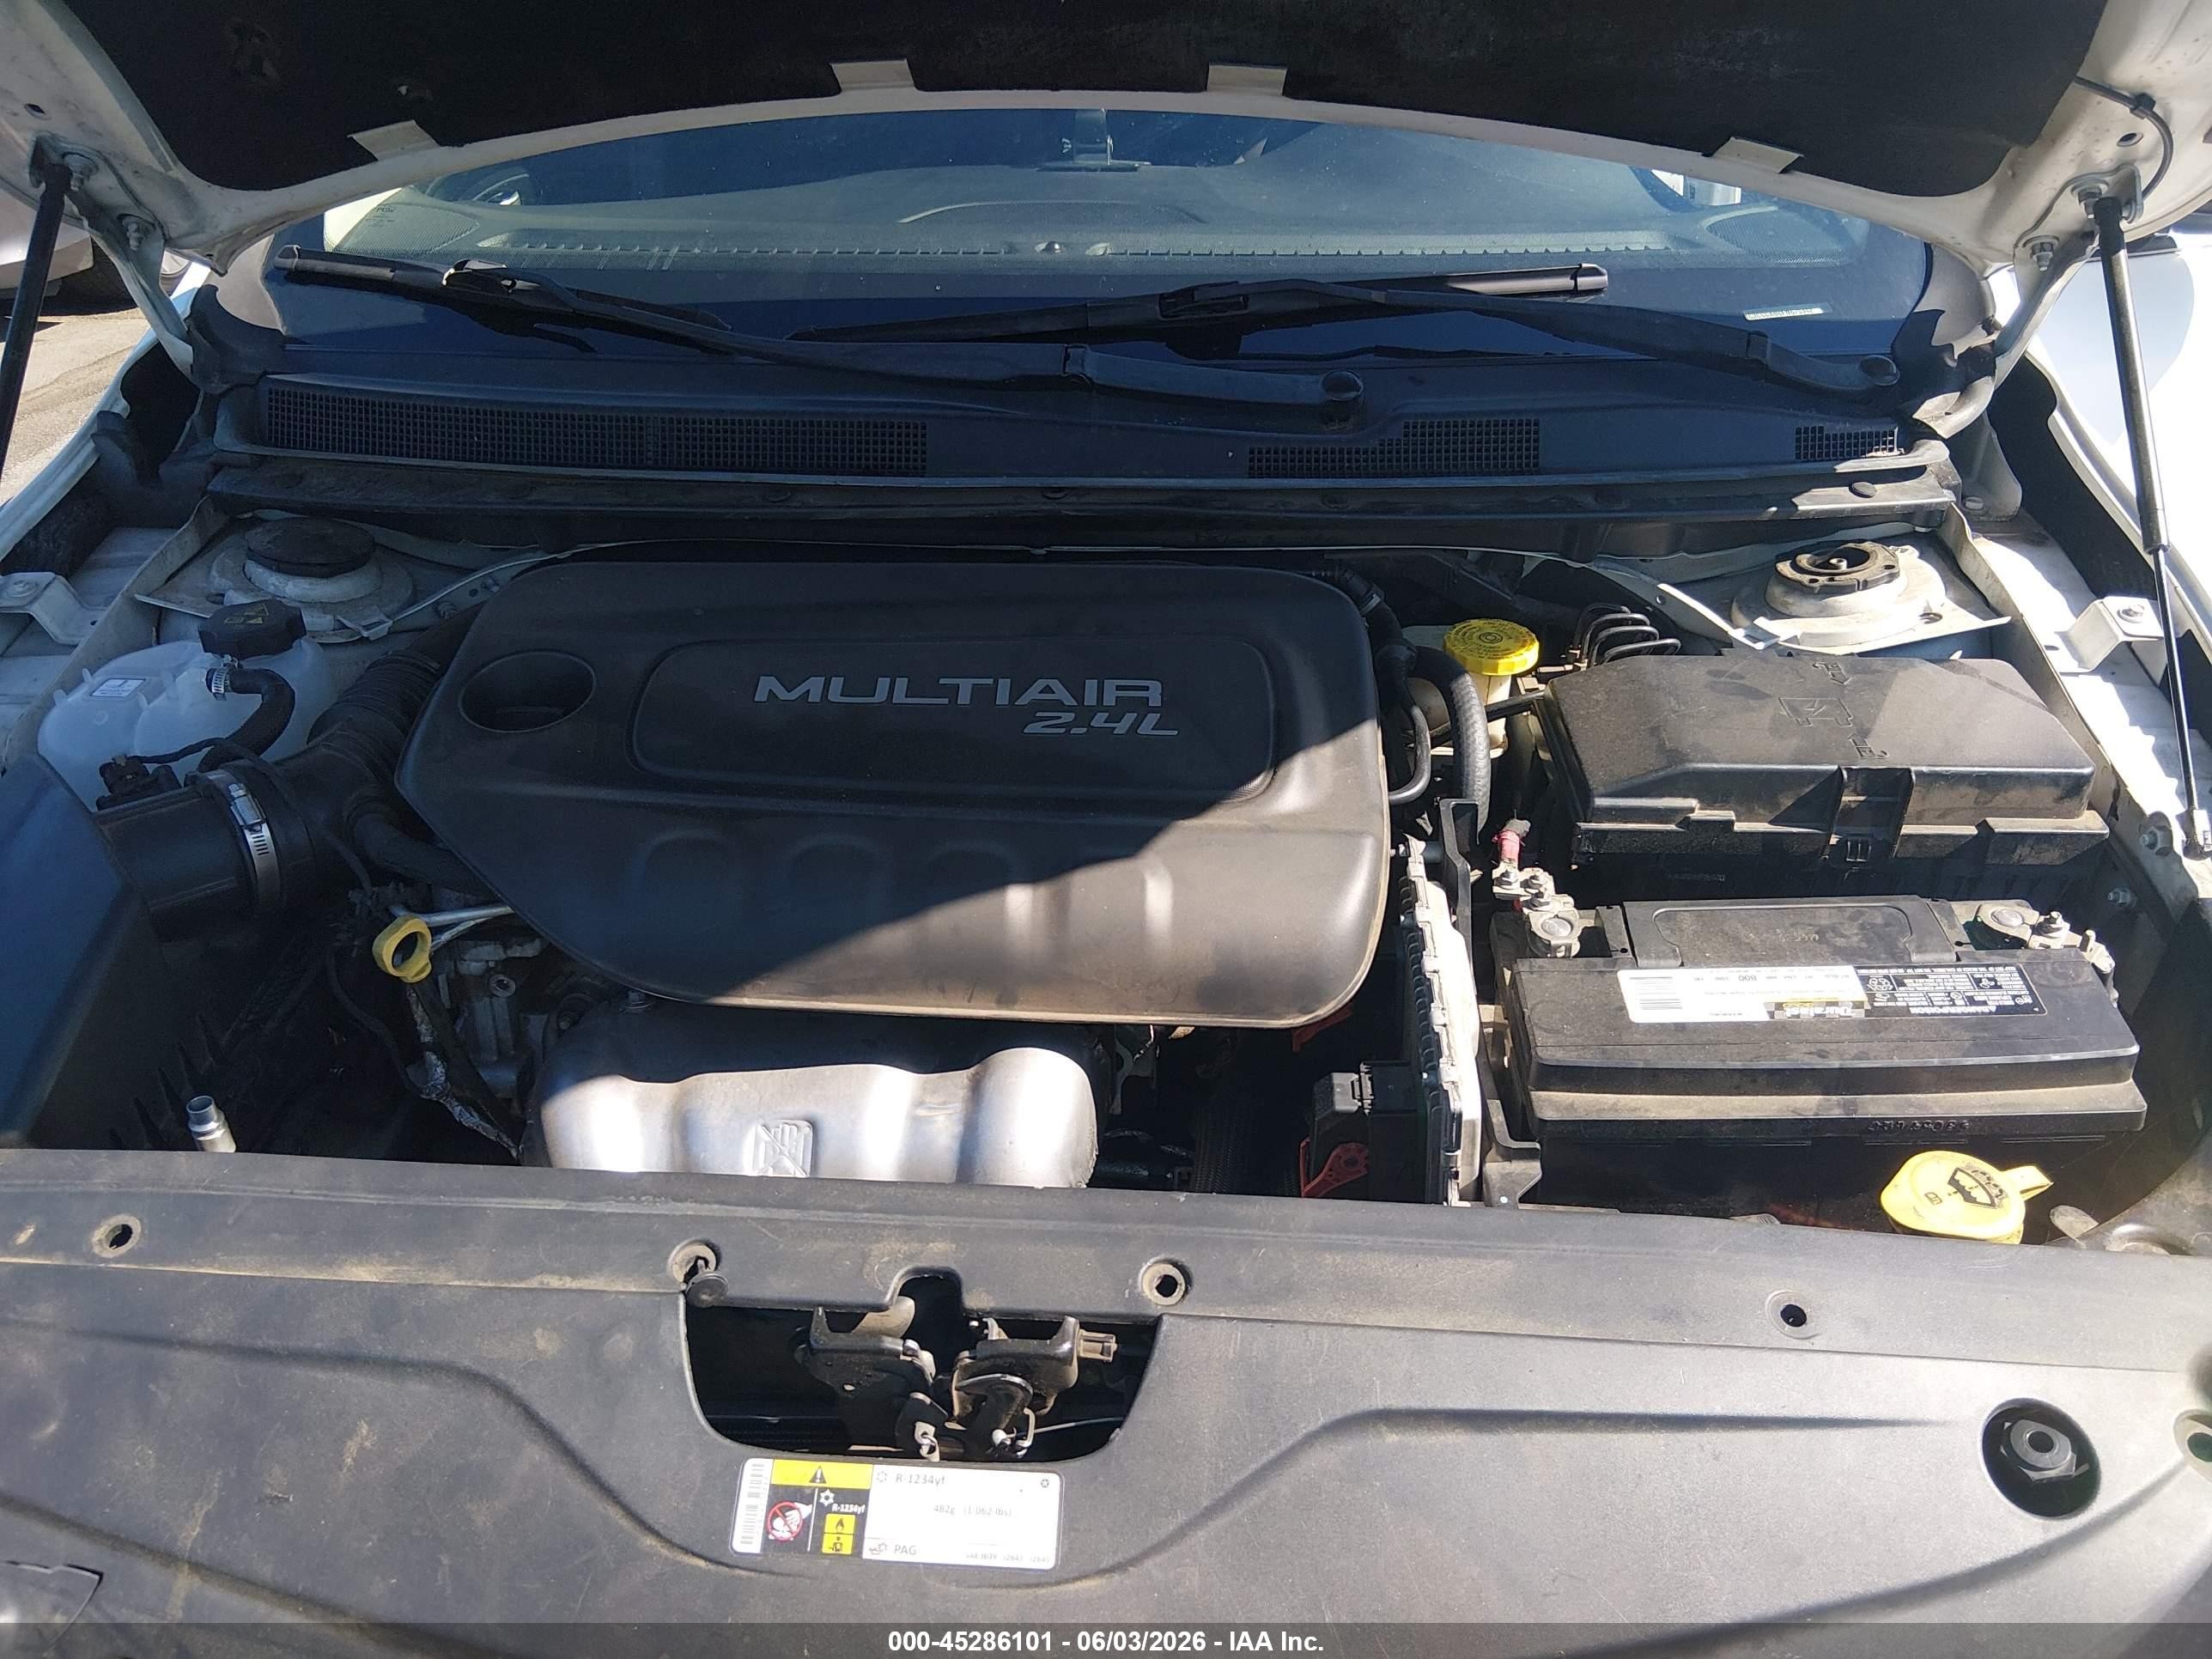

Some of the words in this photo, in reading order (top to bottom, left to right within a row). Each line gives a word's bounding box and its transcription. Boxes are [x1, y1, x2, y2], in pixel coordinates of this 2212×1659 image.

[754, 676, 1163, 707] MULTIAIR
[1023, 712, 1180, 736] 2.4L
[1784, 1002, 1855, 1018] Duralast
[895, 1473, 945, 1486] R-1234yf
[832, 1504, 866, 1515] R-1234yf
[933, 1504, 956, 1516] 482g
[893, 1545, 917, 1556] PAG
